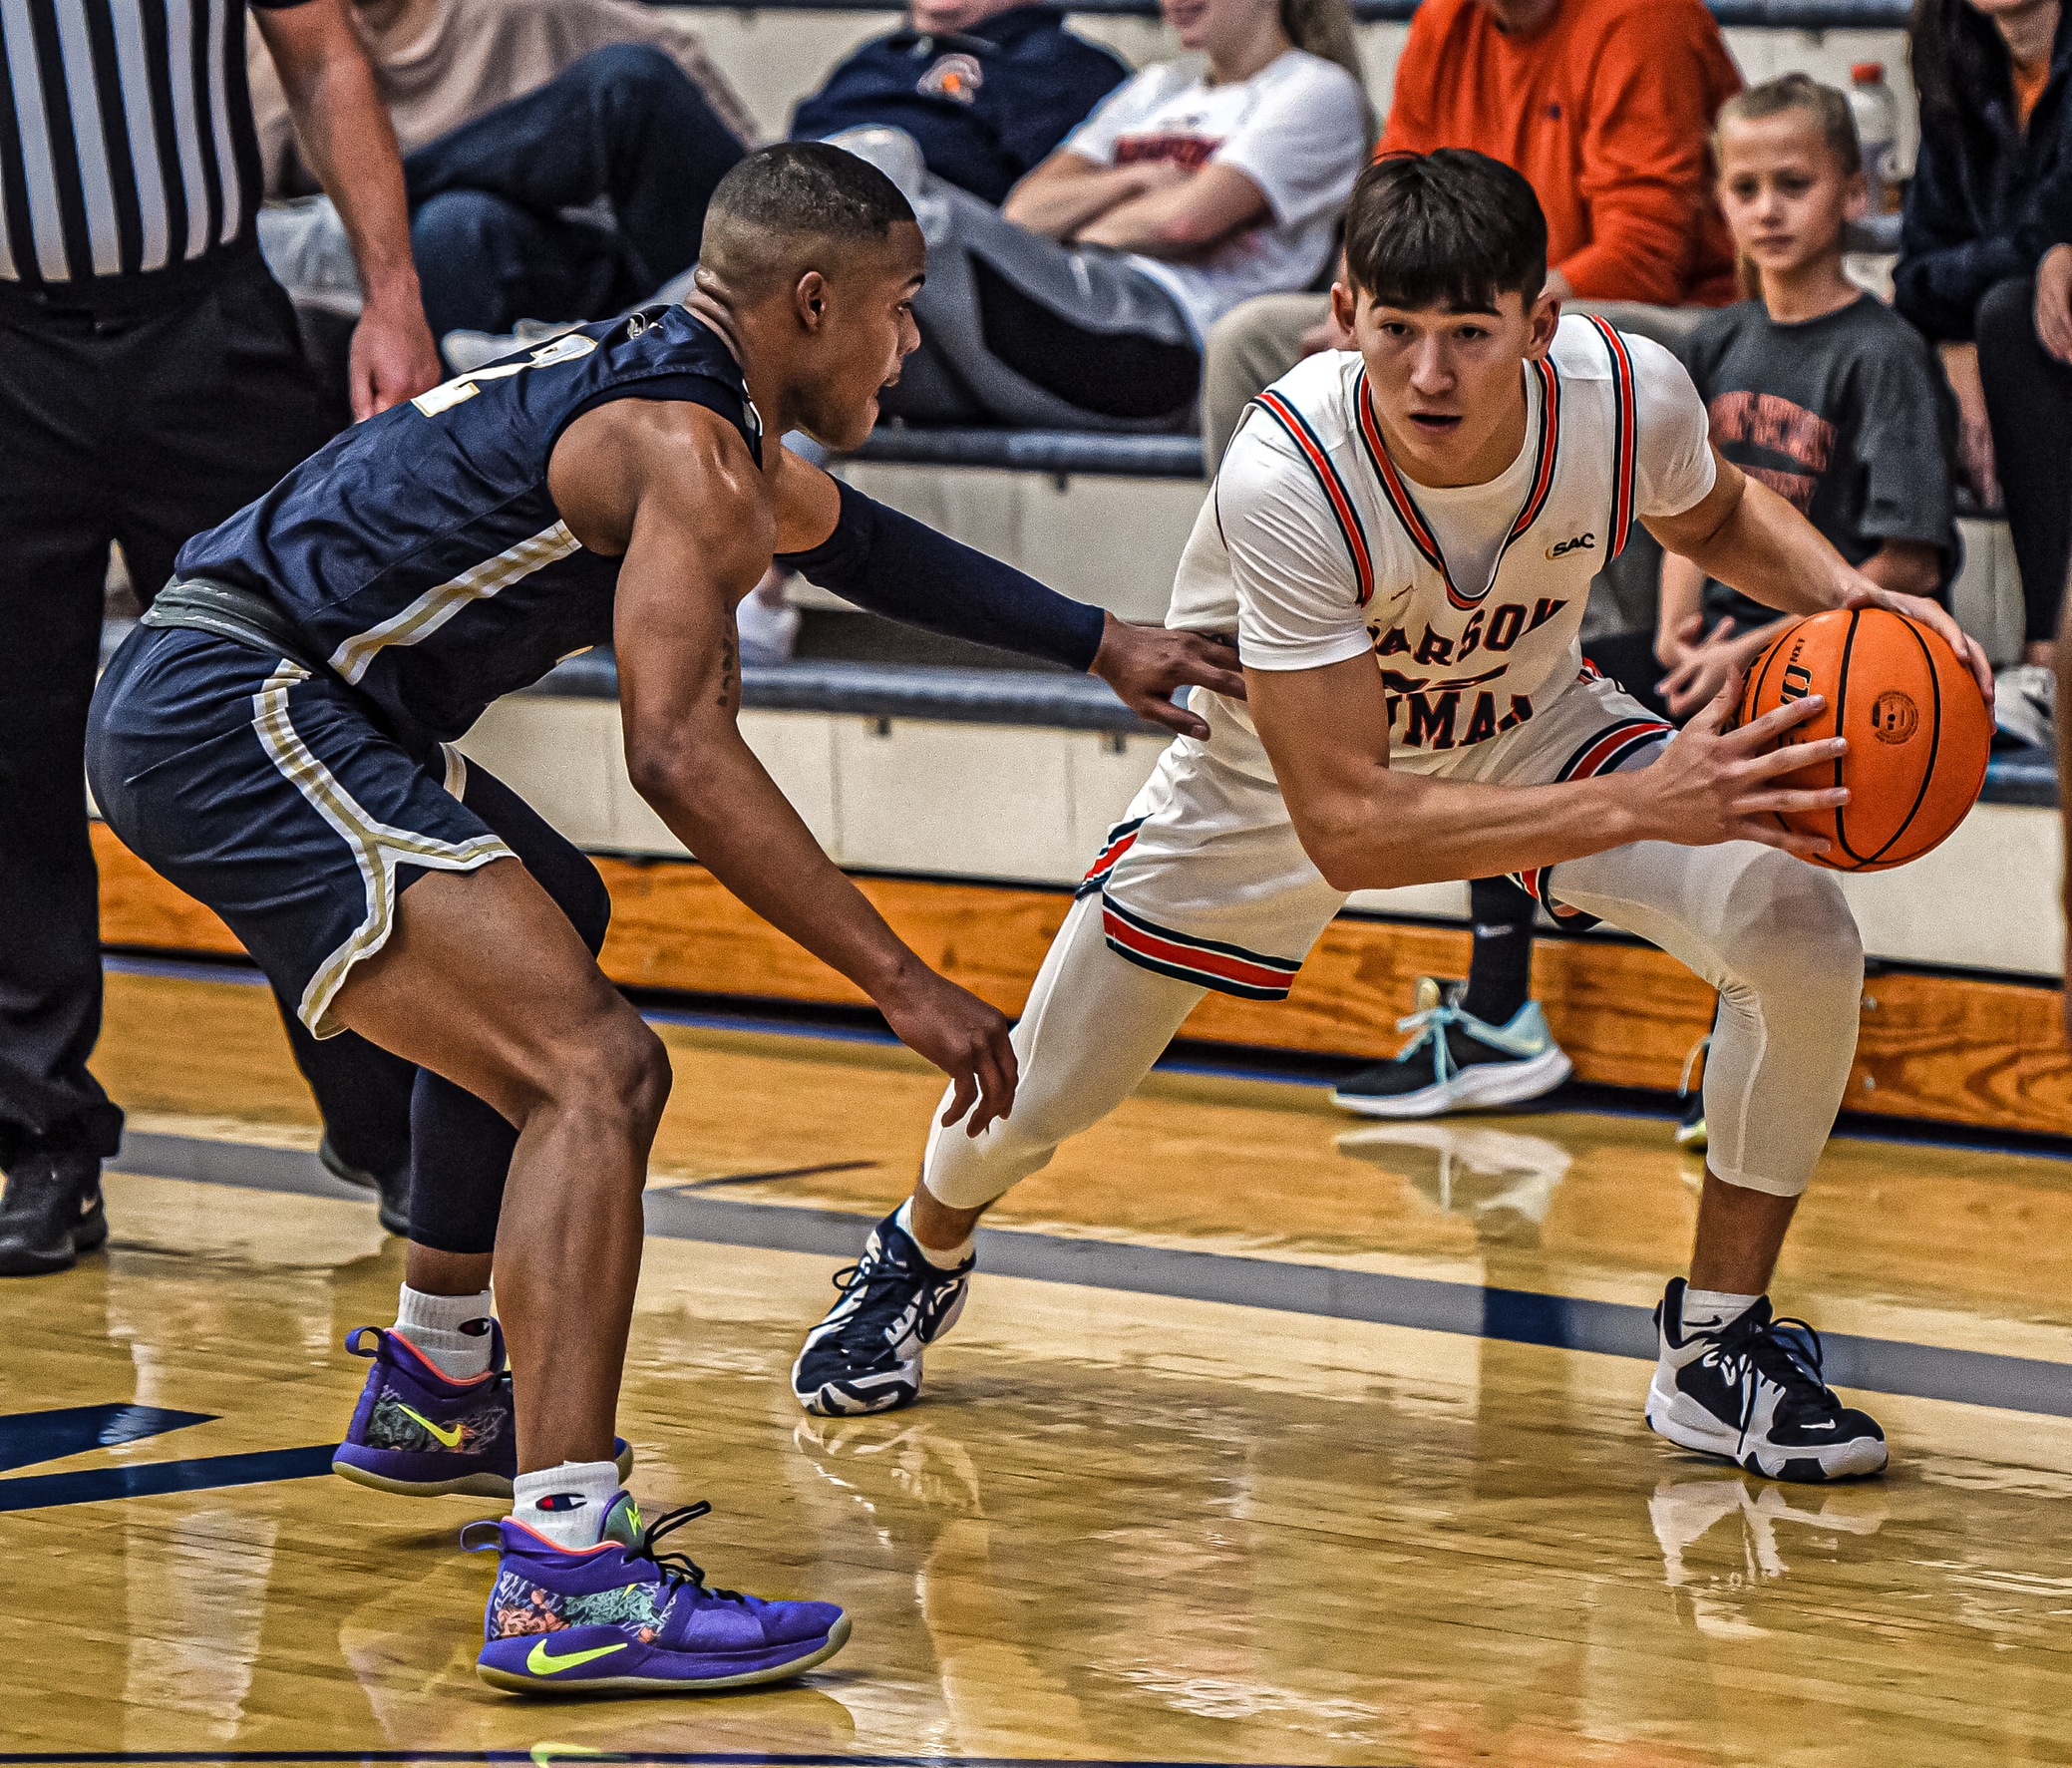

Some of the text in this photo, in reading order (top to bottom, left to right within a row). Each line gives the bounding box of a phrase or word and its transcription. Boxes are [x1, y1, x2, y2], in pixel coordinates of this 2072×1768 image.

[1553, 532, 1595, 556] SAC
[1366, 597, 1568, 666] ARSO
[1790, 637, 1806, 663] NXT
